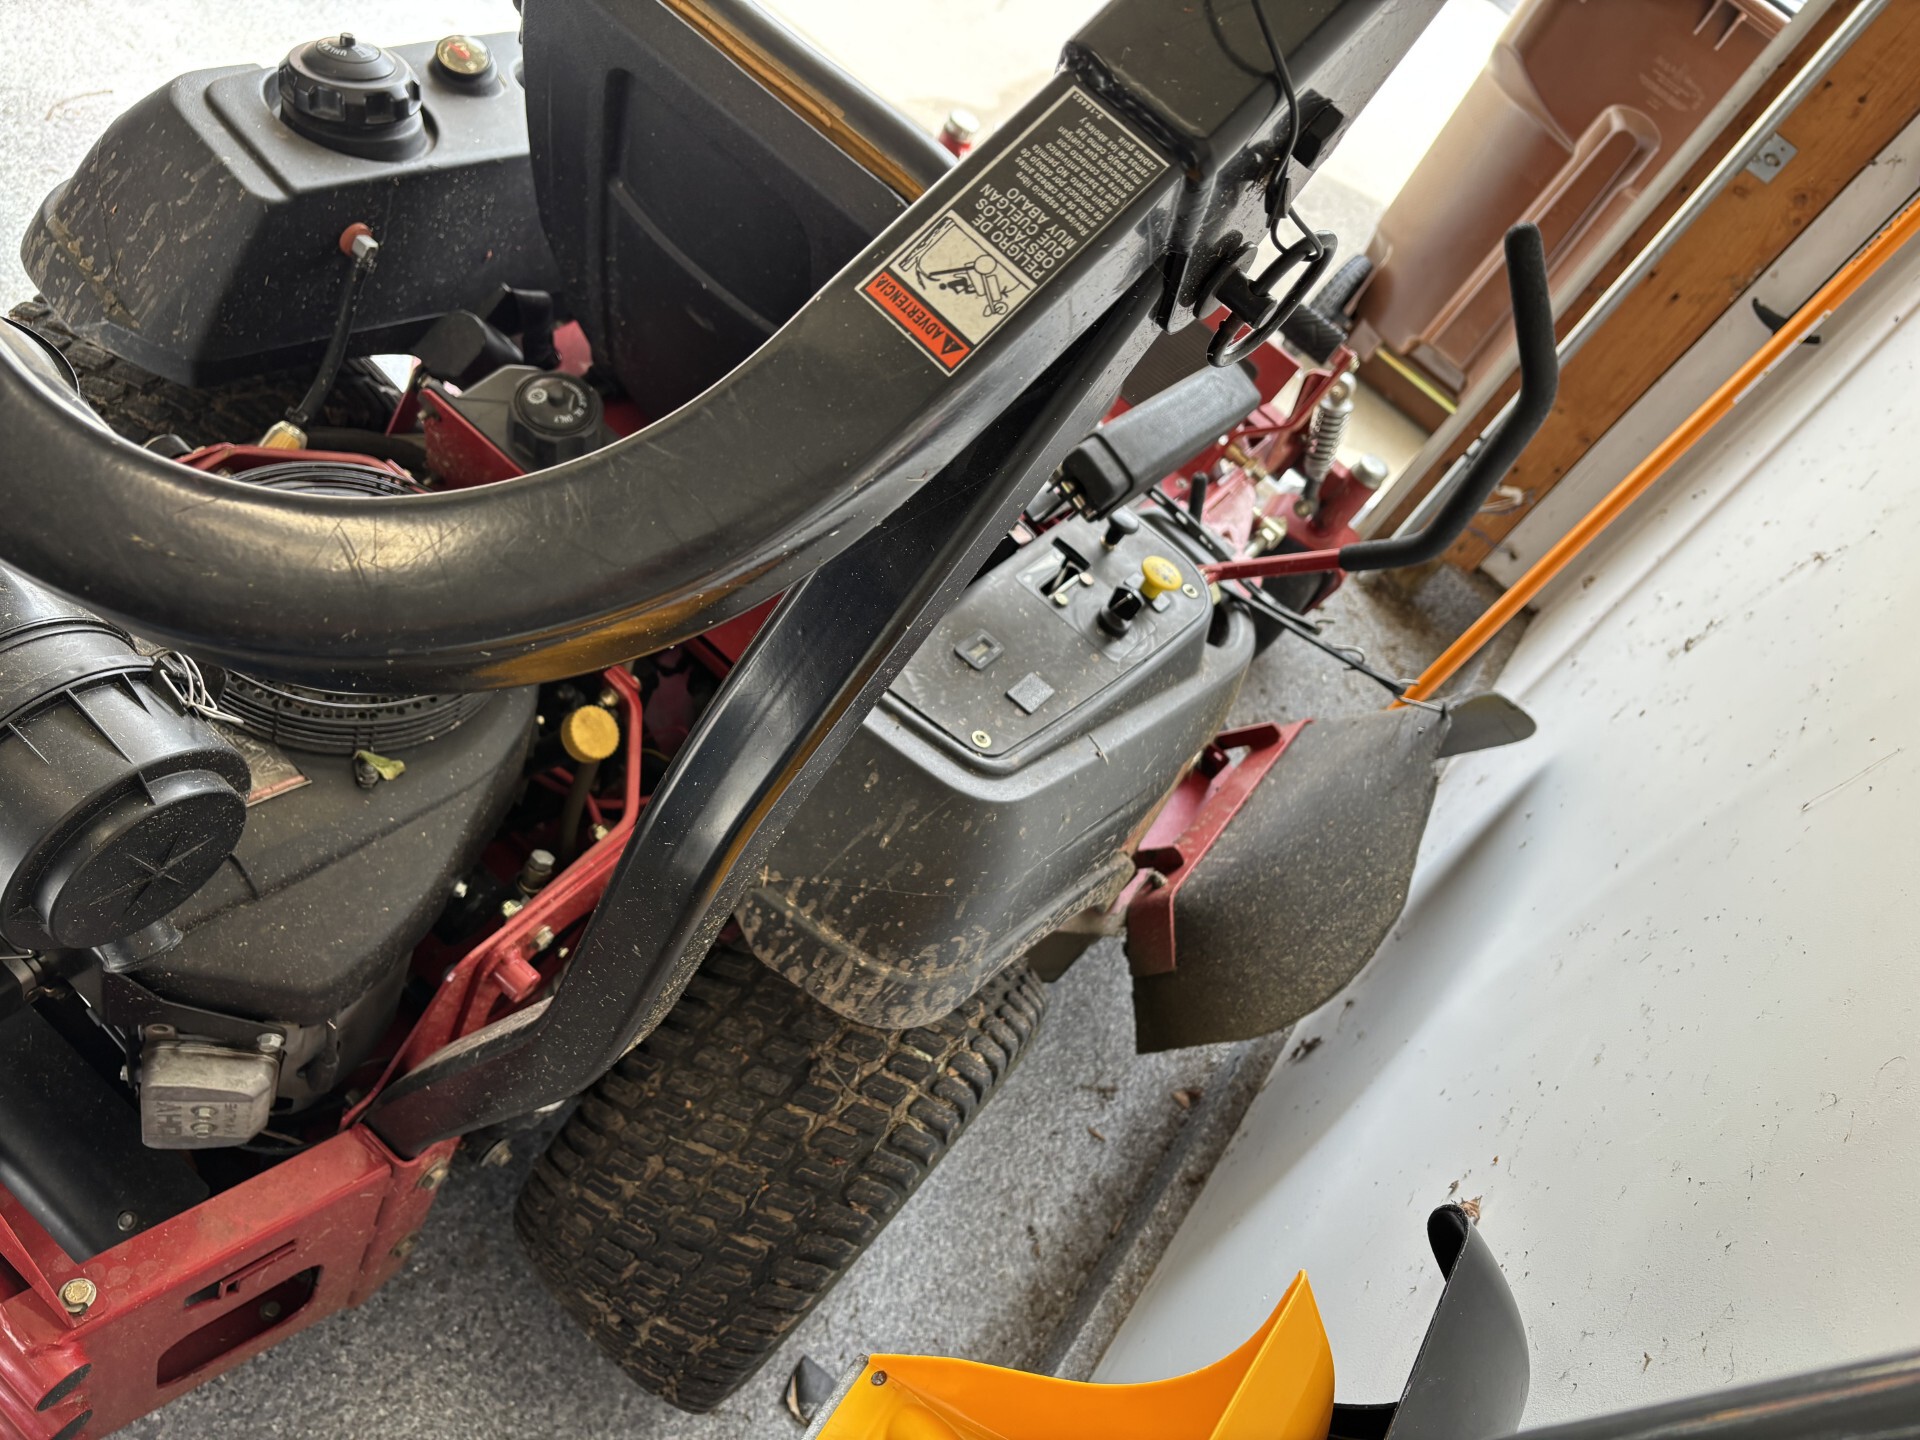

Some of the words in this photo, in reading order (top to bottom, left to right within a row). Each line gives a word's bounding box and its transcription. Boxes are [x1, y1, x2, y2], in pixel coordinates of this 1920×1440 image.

[1078, 116, 1089, 124] y
[1057, 125, 1086, 150] cuelgan
[1075, 127, 1088, 140] las
[1020, 147, 1032, 158] de
[1056, 137, 1072, 151] con
[1083, 147, 1099, 161] que
[1086, 136, 1108, 155] como
[1106, 140, 1123, 154] los
[1031, 143, 1061, 168] permita
[1045, 142, 1082, 173] antivuelco
[1069, 149, 1101, 176] contacto
[1106, 151, 1128, 172] abajo,
[1117, 149, 1130, 160] de
[1133, 149, 1158, 171] cables
[1014, 156, 1036, 175] antes
[1029, 155, 1054, 177] debajo
[1055, 165, 1070, 178] NO
[1127, 157, 1151, 178] ramas
[1015, 170, 1034, 188] libre
[1033, 172, 1059, 195] cabeza
[1051, 172, 1068, 188] por
[1069, 174, 1094, 197] objeto.
[1079, 170, 1100, 190] barra
[1098, 173, 1110, 184] en
[1125, 169, 1143, 185] muy
[1031, 184, 1060, 209] espacio
[1056, 192, 1068, 203] su
[1063, 185, 1096, 213] conducir
[1097, 186, 1107, 196] la
[1104, 192, 1120, 206] que
[1107, 181, 1128, 199] entre
[979, 183, 1039, 236] CUELGAN
[1006, 187, 1051, 224] ABAJO
[1055, 206, 1067, 216] el
[1065, 200, 1077, 211] de
[1093, 210, 1105, 221] de
[971, 213, 994, 234] DE
[1064, 213, 1090, 237] Revise
[1074, 208, 1098, 228] arriba
[1036, 232, 1066, 259] QUE
[1045, 223, 1078, 250] MUY
[990, 230, 1046, 280] PELIGRO
[875, 275, 946, 340] ADVERTENCIA
